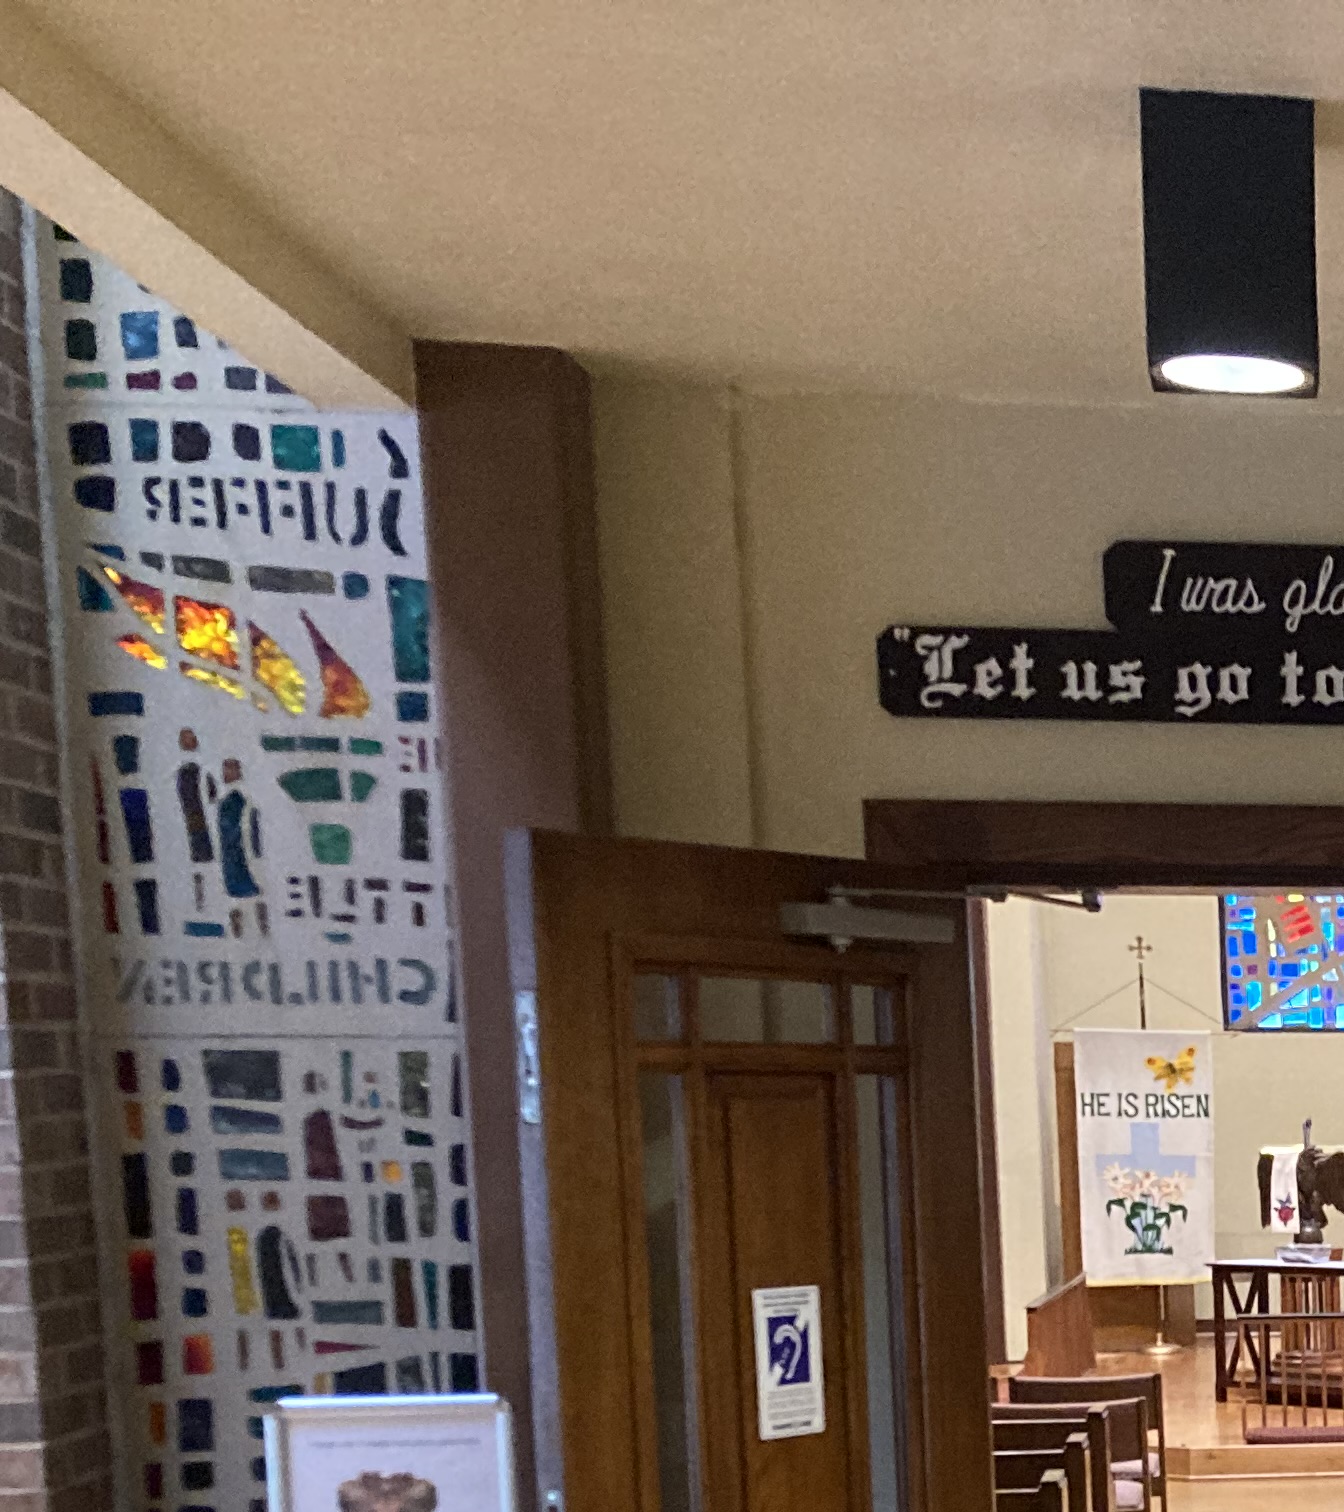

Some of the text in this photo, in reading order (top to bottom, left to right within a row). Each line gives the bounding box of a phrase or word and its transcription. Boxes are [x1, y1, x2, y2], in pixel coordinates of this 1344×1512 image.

[1149, 548, 1176, 613] I
[1180, 576, 1266, 614] was
[1061, 661, 1145, 703] us
[1174, 662, 1253, 717] go
[1080, 1093, 1209, 1118] HE IS RISEN
